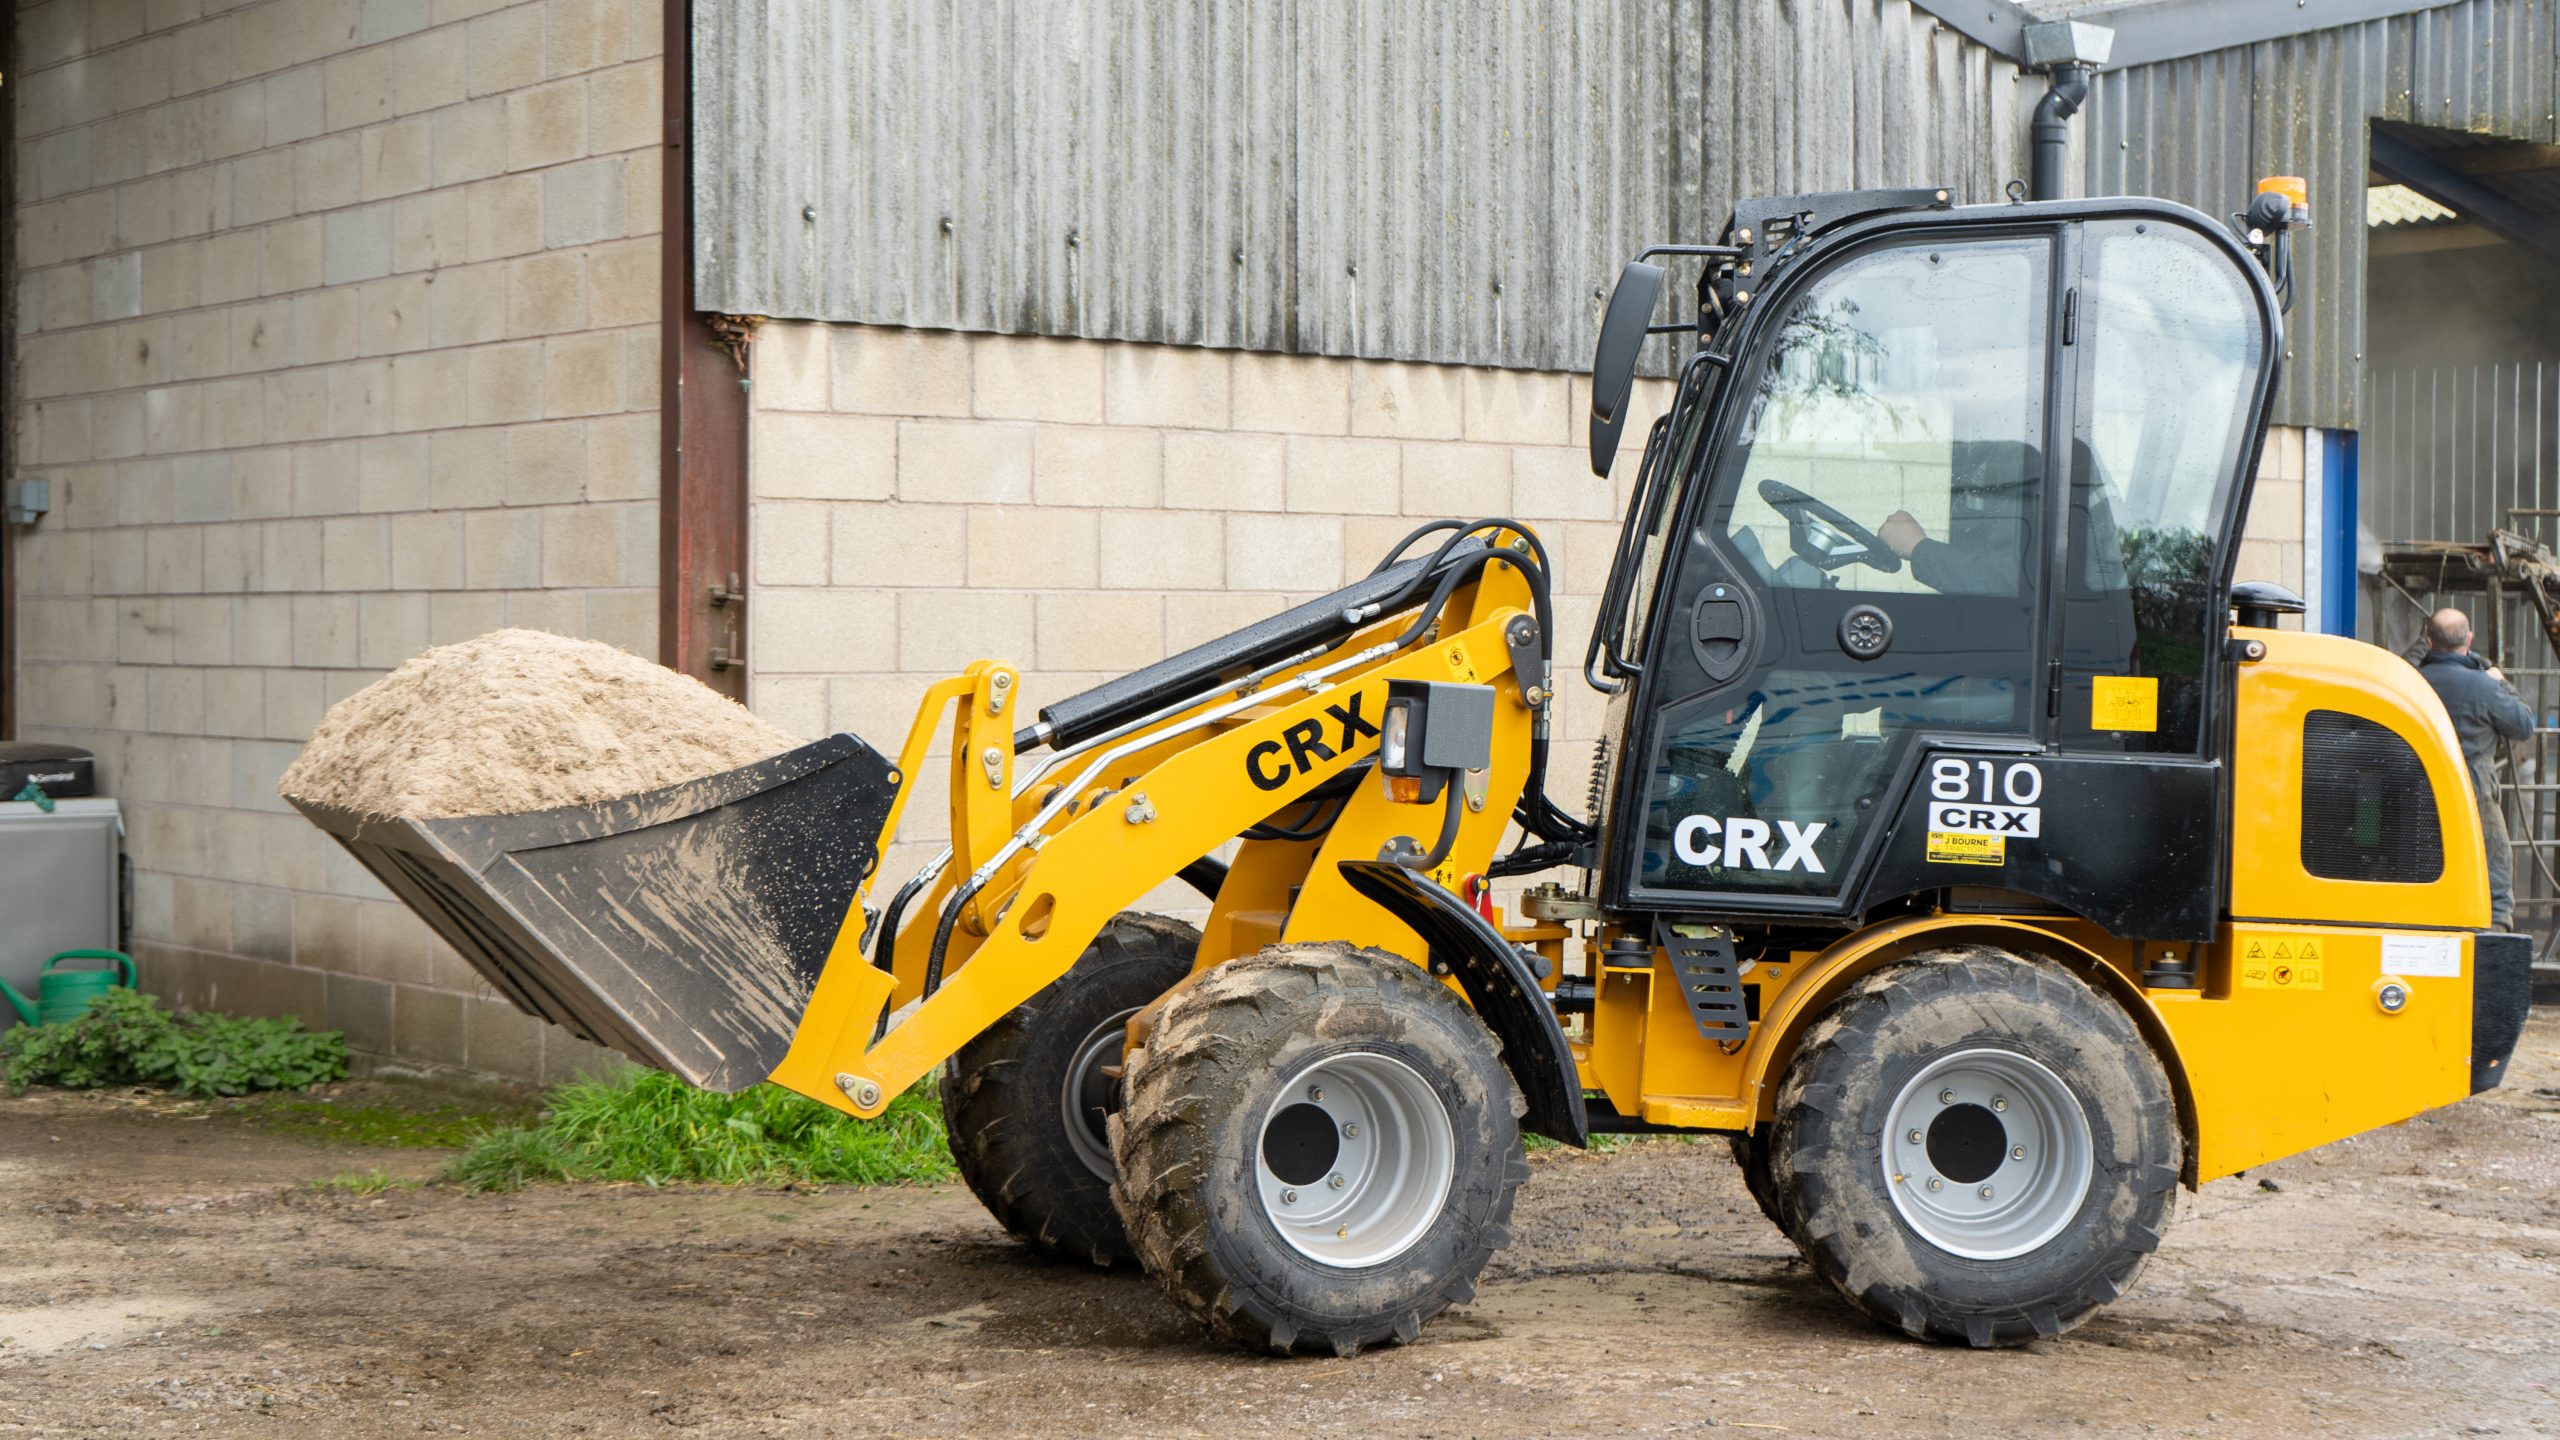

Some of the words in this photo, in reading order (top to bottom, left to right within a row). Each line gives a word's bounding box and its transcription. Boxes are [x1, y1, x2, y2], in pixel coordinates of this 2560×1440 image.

[1246, 690, 1382, 792] CRX
[1931, 758, 2042, 805] 810
[1939, 808, 2029, 832] CRX
[1945, 837, 1950, 845] J
[1952, 837, 1988, 846] BOURNE
[1673, 814, 1827, 874] CRX
